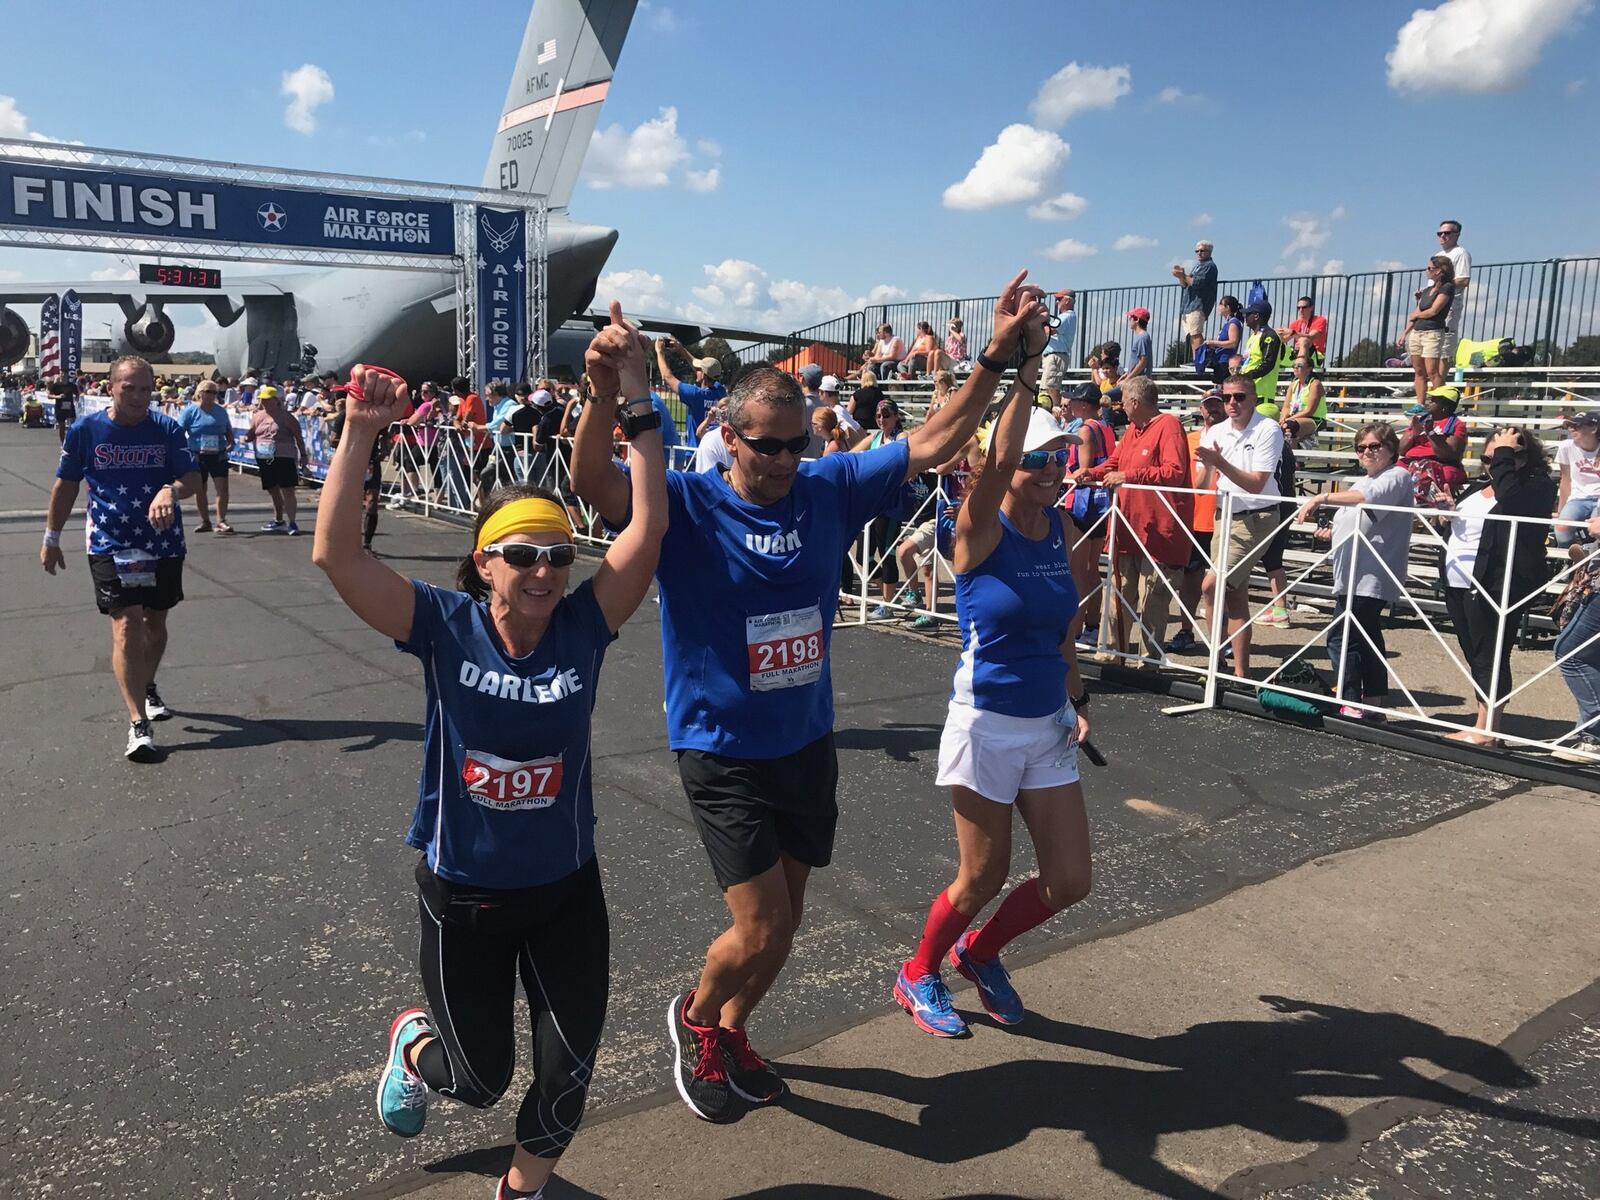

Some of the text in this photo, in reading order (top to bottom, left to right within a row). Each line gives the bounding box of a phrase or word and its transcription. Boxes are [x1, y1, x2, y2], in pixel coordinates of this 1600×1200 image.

[526, 72, 549, 94] AFMC
[507, 130, 533, 153] 70025
[500, 159, 519, 191] ED
[13, 176, 216, 230] FINISH
[324, 206, 429, 228] AIR FORCE
[323, 223, 431, 244] MARATHON
[492, 263, 509, 302] AIR
[63, 312, 81, 321] U.S.
[492, 307, 510, 371] FORCE
[93, 443, 166, 467] Stars
[757, 635, 819, 671] 2198
[459, 660, 584, 704] DARLENE
[761, 669, 781, 679] FULL
[782, 661, 820, 676] MARATHON
[469, 766, 553, 799] 2197
[471, 794, 548, 809] FULL MARATHON
